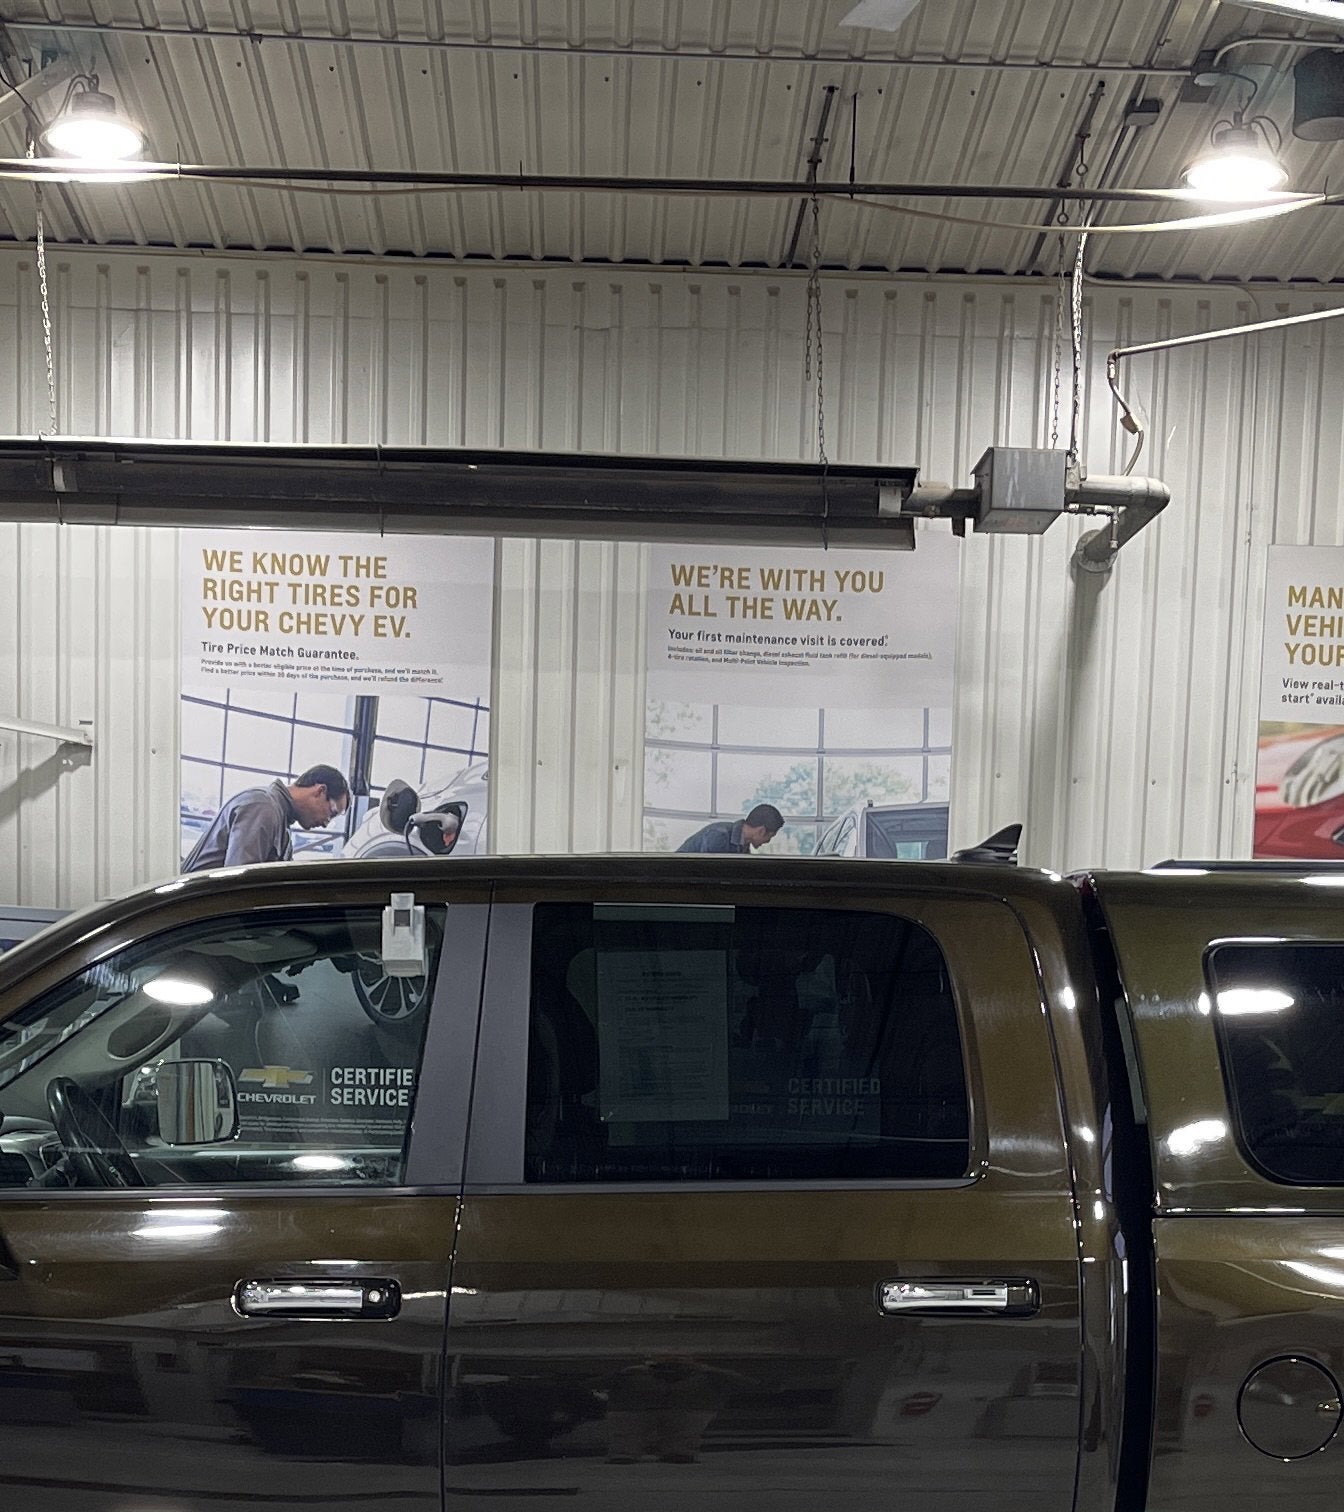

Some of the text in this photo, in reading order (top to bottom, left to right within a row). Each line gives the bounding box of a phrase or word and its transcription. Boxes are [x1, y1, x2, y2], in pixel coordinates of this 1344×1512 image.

[202, 548, 388, 579] WE KNOW THE
[670, 564, 884, 594] WE'RE WITH YOU
[202, 577, 418, 609] RIGHT TIRES FOR
[669, 593, 842, 622] ALL THE WAY.
[201, 606, 411, 639] YOUR CHEVY EV.
[668, 628, 694, 640] Your
[697, 630, 722, 643] first
[725, 632, 798, 646] maintenance
[800, 634, 825, 646] visit
[827, 635, 837, 646] is
[201, 641, 360, 661] Tire Price Match Guarantee.
[1282, 677, 1309, 689] View
[330, 1067, 414, 1087] CERTIFIE
[236, 1092, 317, 1104] CHEVROLET
[330, 1087, 409, 1106] SERVICE
